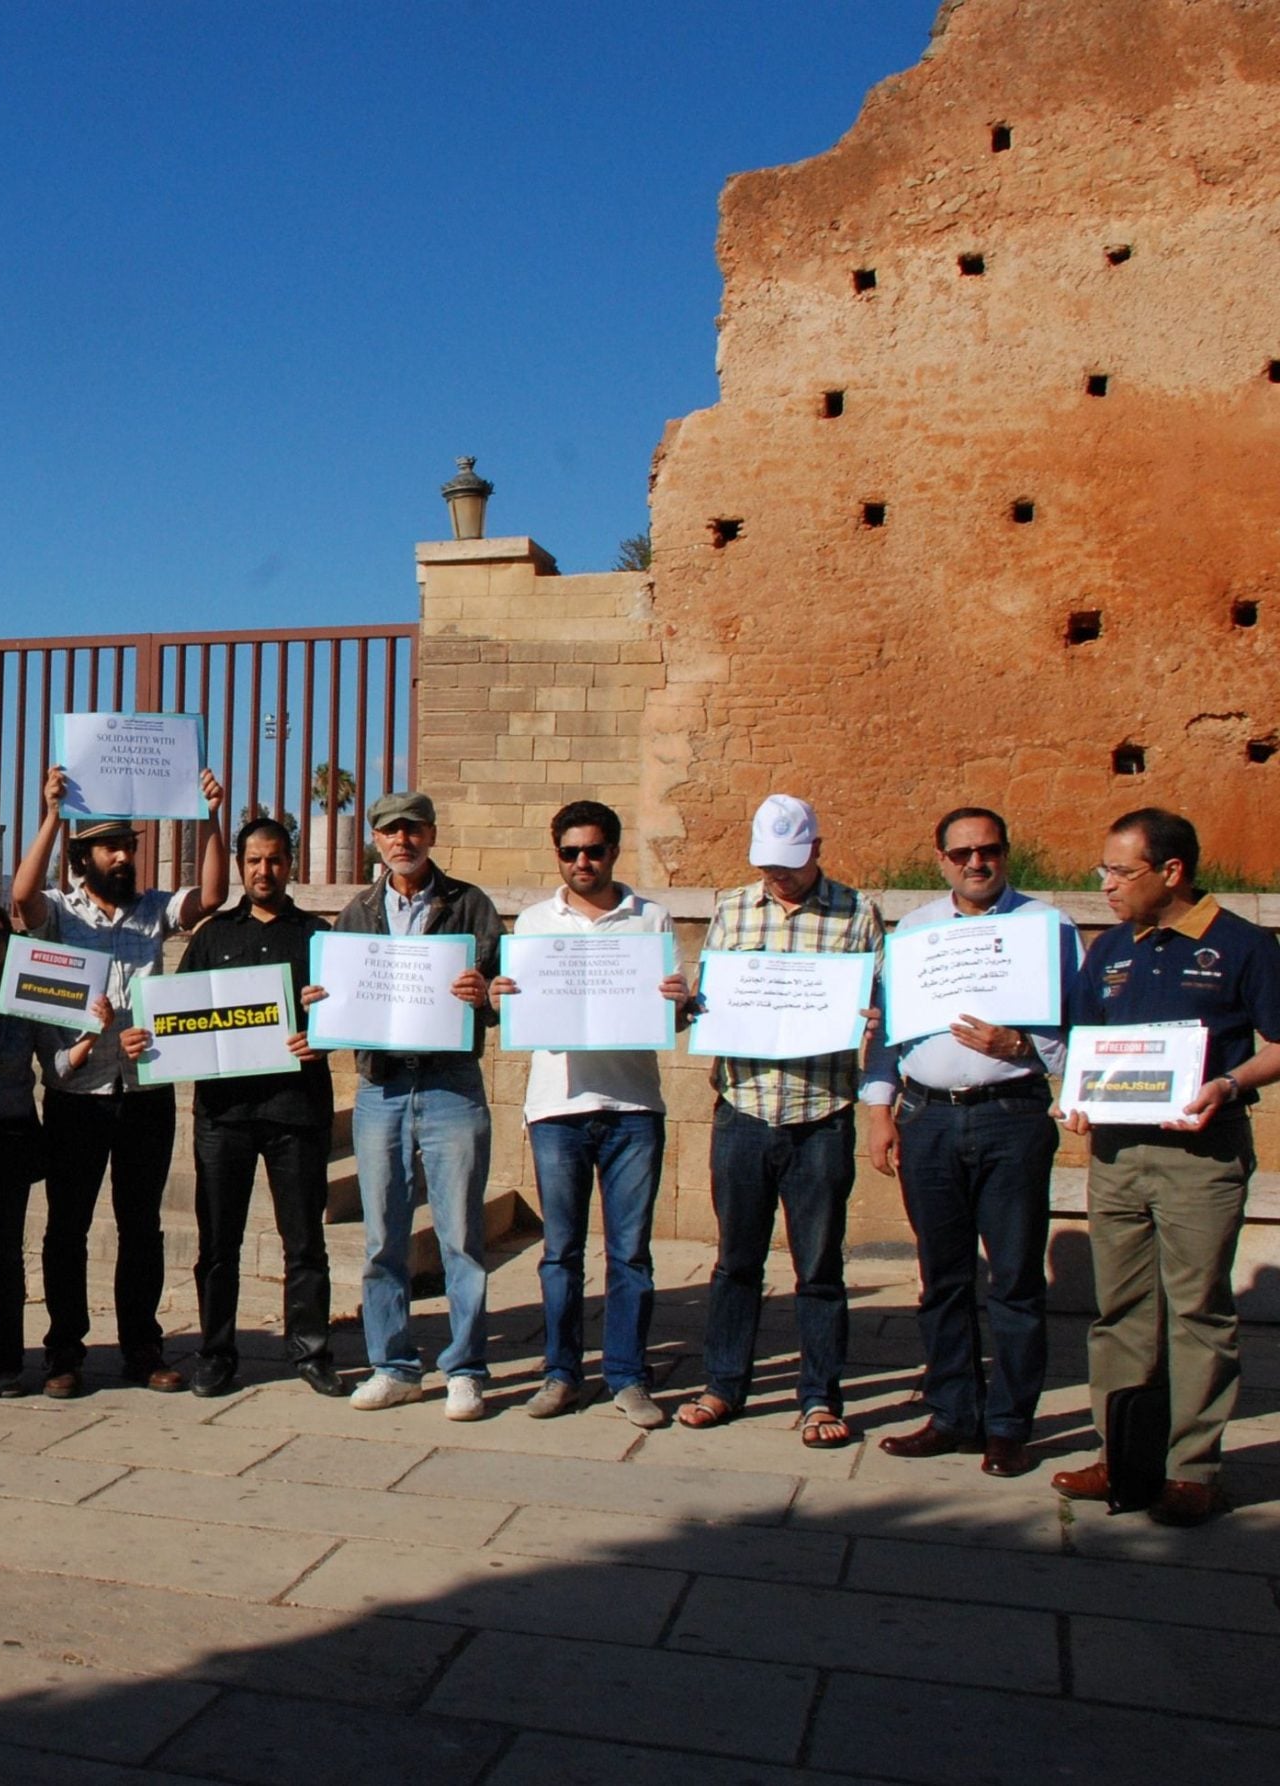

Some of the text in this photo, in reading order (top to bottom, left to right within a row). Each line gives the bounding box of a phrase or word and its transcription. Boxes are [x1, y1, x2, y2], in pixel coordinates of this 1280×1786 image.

[96, 734, 176, 747] SOLIDARITY WITH
[100, 755, 170, 766] JOURNALISTS IN
[100, 766, 170, 777] EGYPTIAN JAILS
[413, 961, 432, 971] FOR
[21, 983, 84, 1000] #FreeAJStaff
[358, 980, 435, 994] JOURNALISTS IN
[356, 991, 435, 1006] EGYPTIAN JAILS
[154, 1006, 281, 1034] #FreeAJStaff
